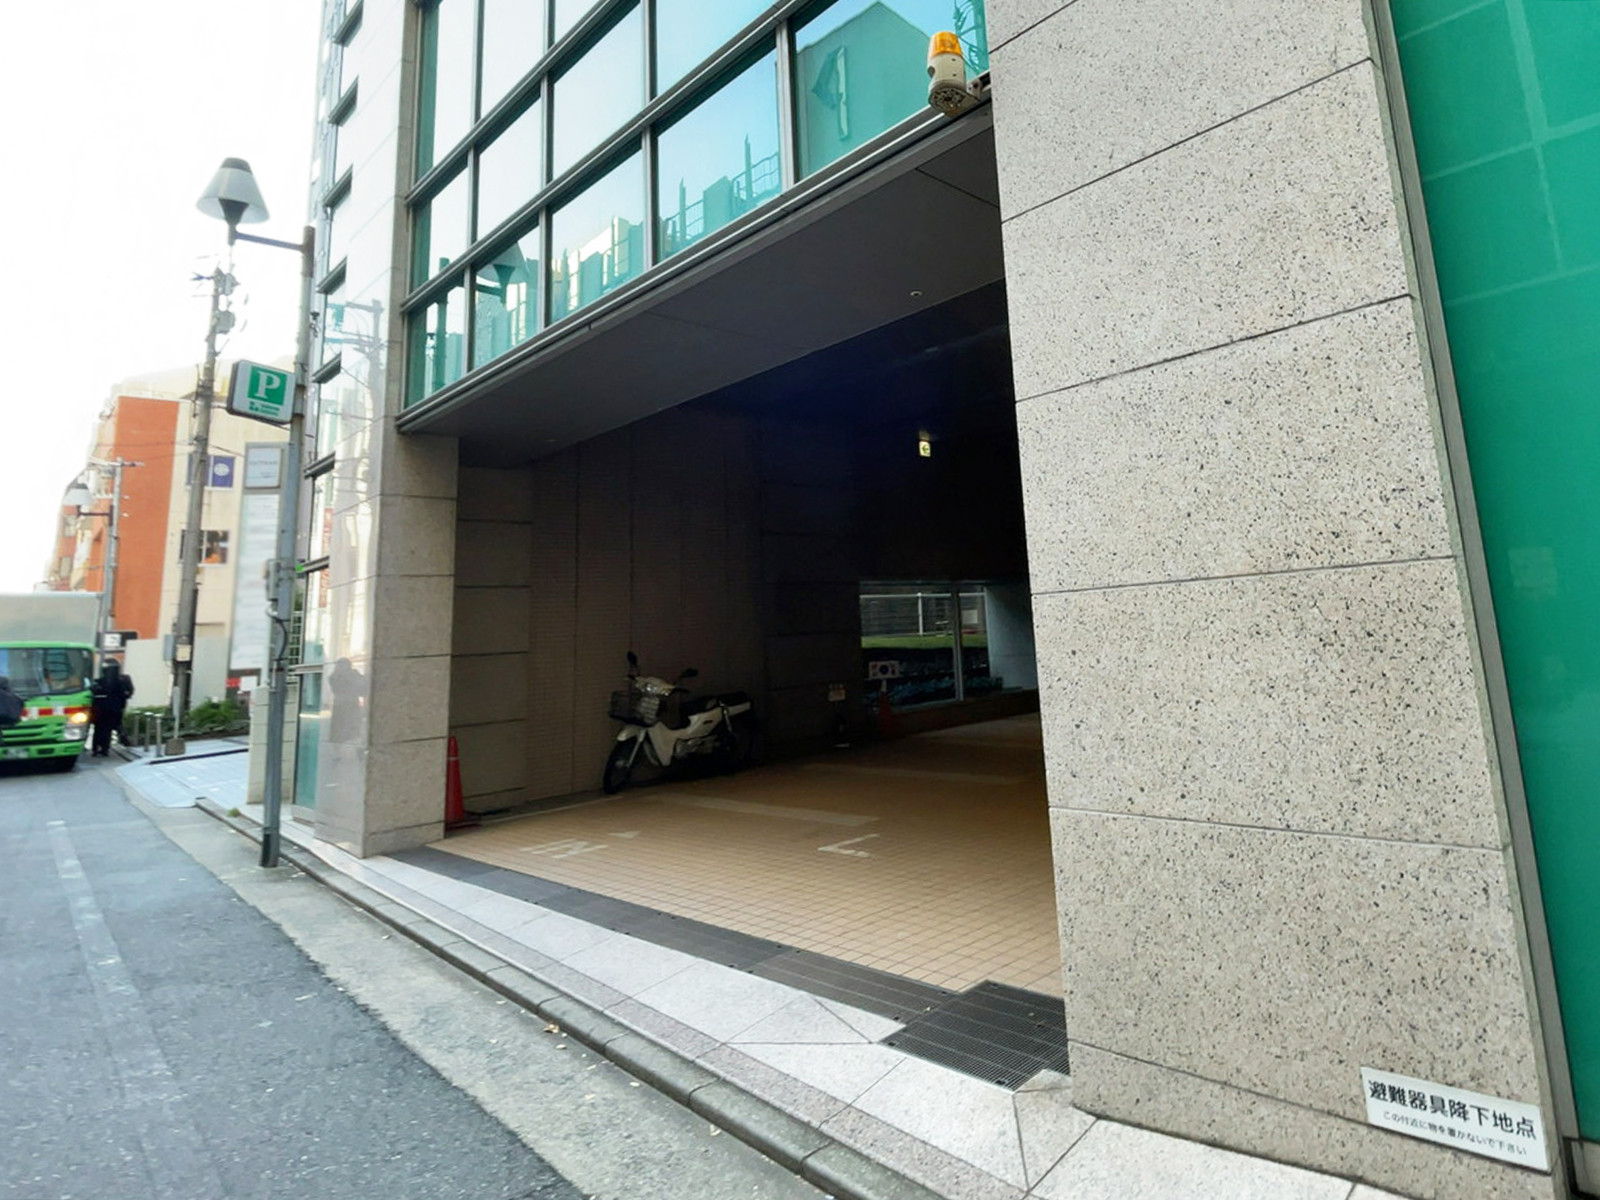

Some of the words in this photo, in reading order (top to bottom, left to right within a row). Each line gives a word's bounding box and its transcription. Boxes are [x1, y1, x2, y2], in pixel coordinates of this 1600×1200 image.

[254, 370, 281, 400] P
[1367, 1079, 1537, 1141] 避難器具降下地点
